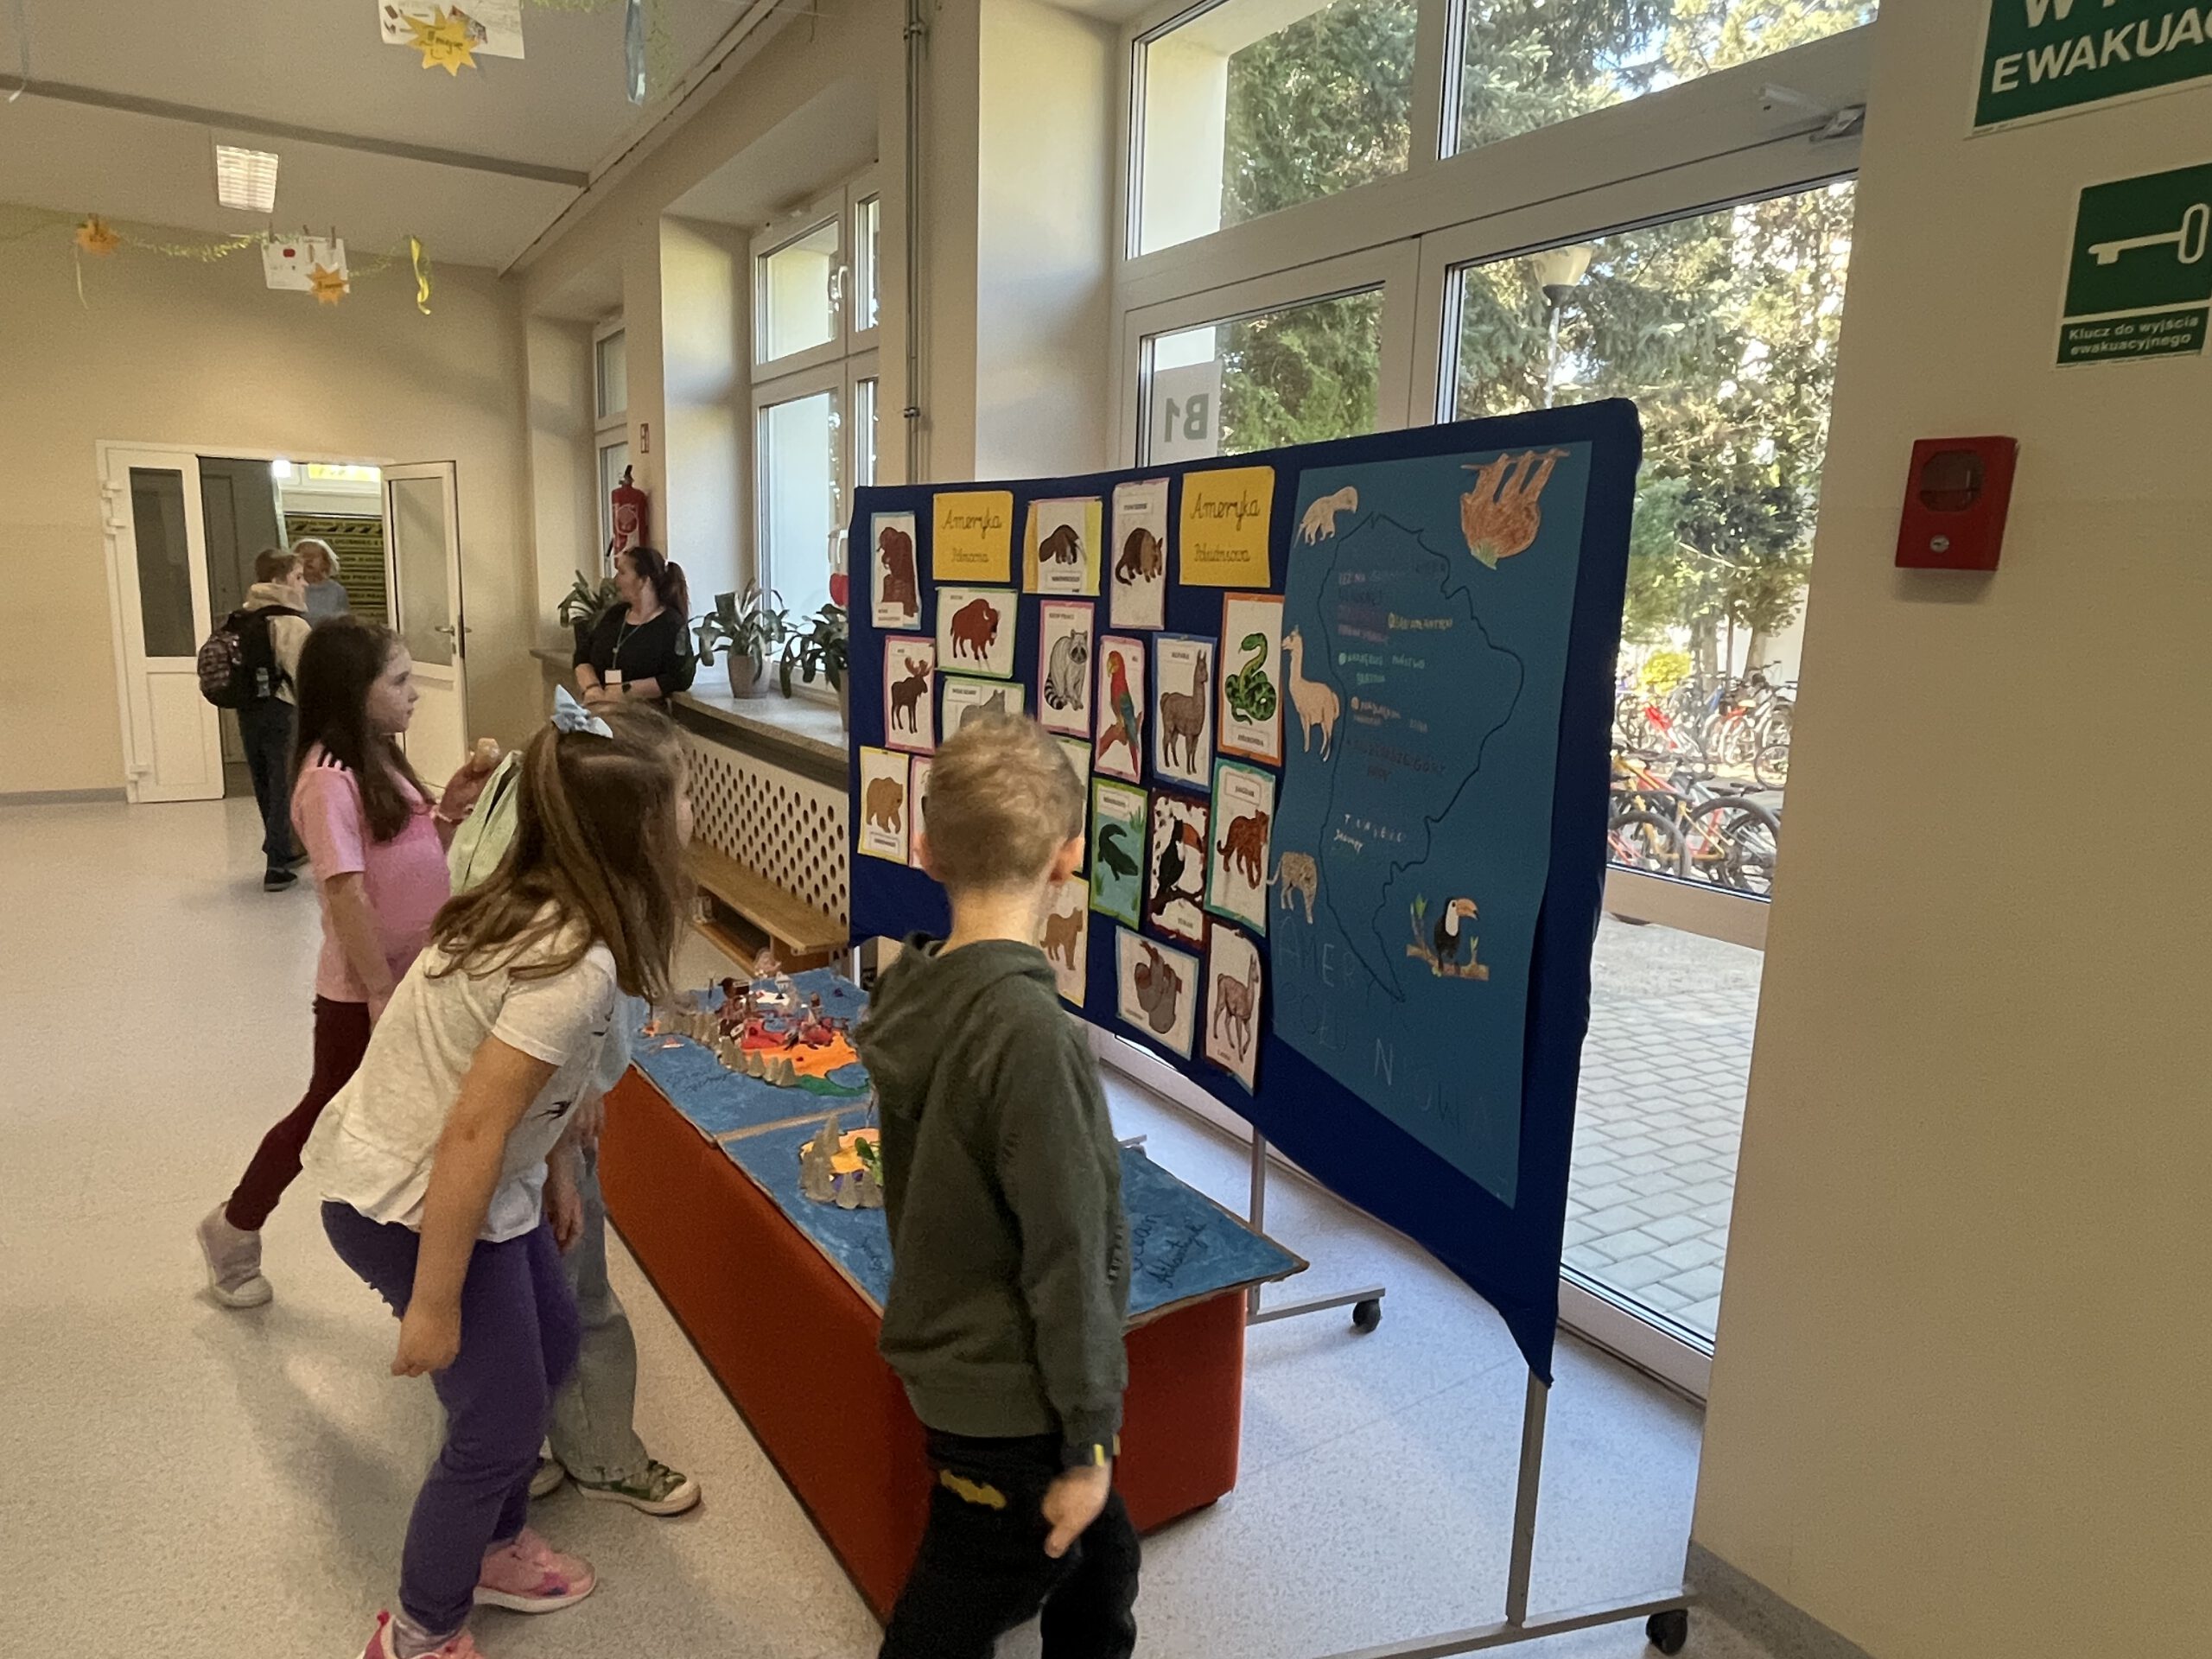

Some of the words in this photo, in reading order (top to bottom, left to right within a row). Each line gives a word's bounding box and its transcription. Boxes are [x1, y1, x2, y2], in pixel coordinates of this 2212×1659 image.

[1991, 7, 2212, 94] EWAKUA
[2069, 327, 2111, 340] Klucz
[2114, 323, 2134, 335] do
[2139, 315, 2199, 334] wyjścia
[2070, 333, 2192, 356] ewakuacyjnego
[942, 506, 1002, 539] Ameryka
[1190, 489, 1261, 531] Ameryka
